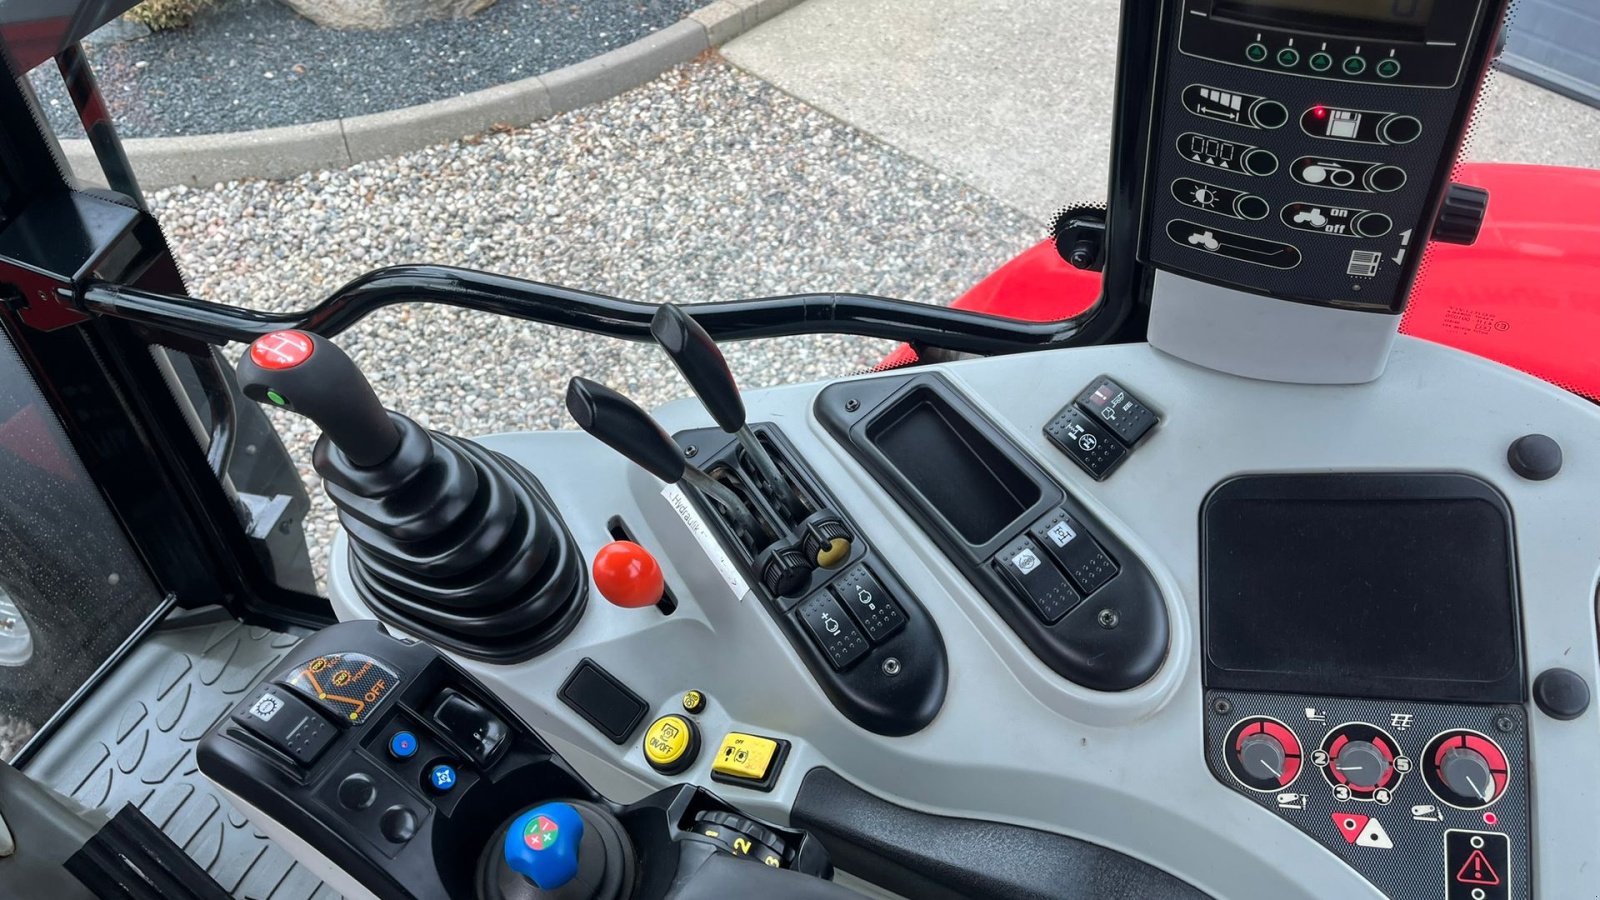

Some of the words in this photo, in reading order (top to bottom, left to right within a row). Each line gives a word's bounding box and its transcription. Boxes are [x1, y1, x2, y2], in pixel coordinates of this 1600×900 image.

[1330, 209, 1348, 217] on
[1325, 224, 1345, 233] off
[672, 494, 699, 534] Hydraulik
[364, 679, 386, 702] OFF
[650, 737, 673, 754] ON/OFF
[1314, 751, 1326, 765] 2
[1396, 758, 1409, 771] 5
[1336, 787, 1348, 799] 3
[1376, 790, 1389, 803] 4
[734, 838, 752, 854] 2
[765, 856, 779, 868] 3
